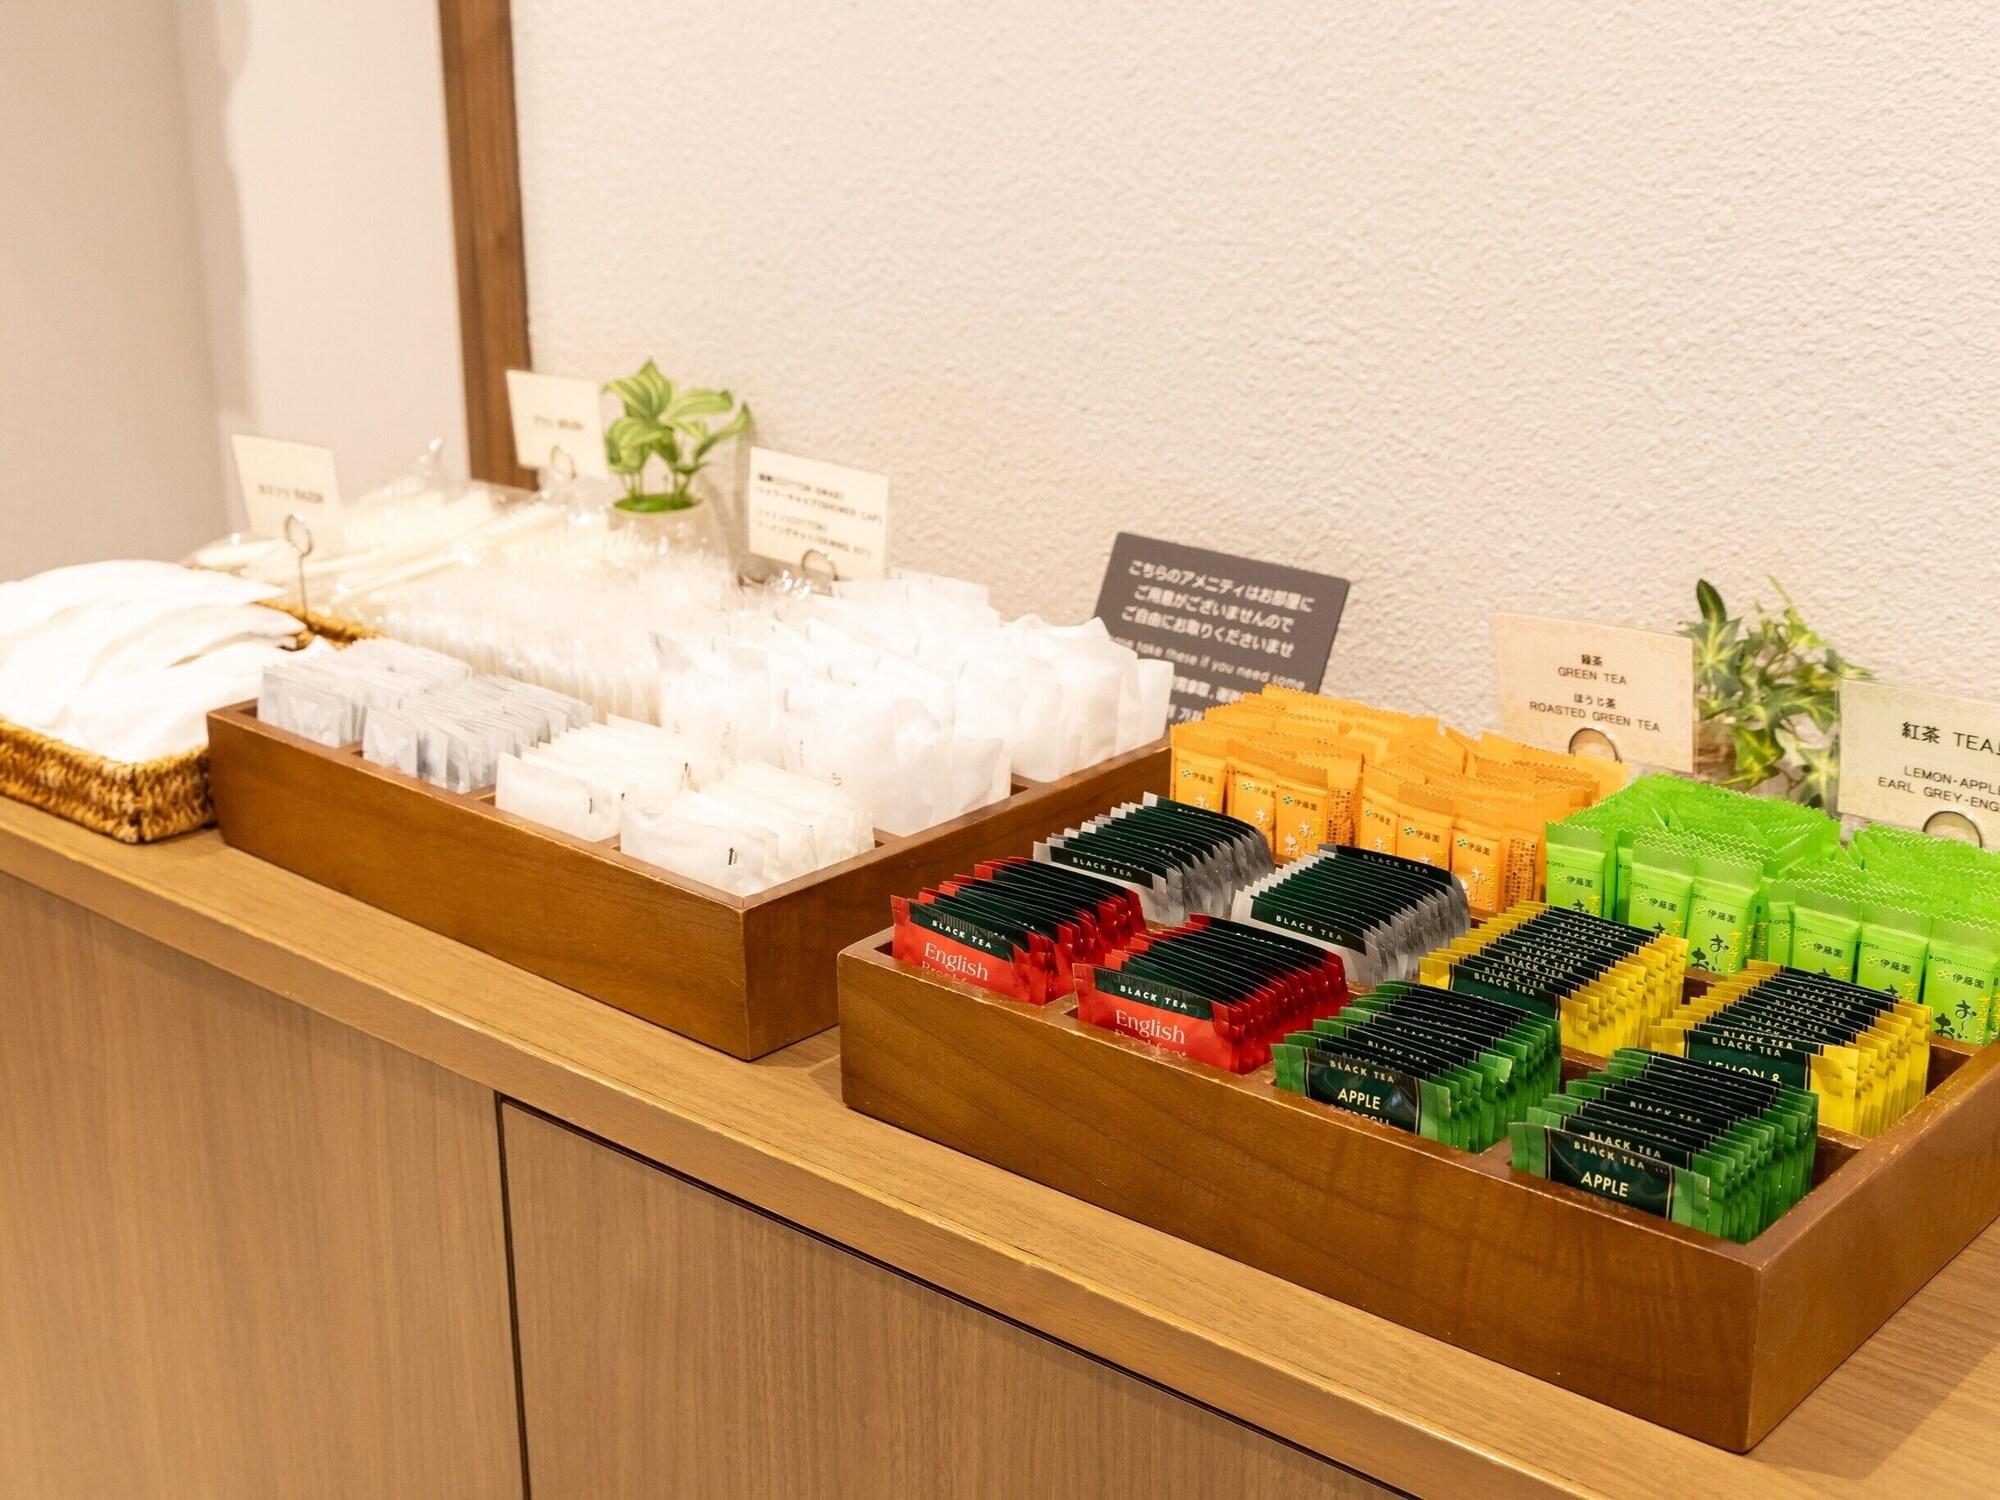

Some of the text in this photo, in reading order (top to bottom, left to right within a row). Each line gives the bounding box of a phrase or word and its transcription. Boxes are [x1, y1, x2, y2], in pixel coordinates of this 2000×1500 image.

[1211, 660, 1236, 675] you
[1236, 666, 1271, 682] need
[1558, 666, 1627, 685] GREEN TEA
[1574, 693, 1616, 709] ほうじ茶
[1529, 701, 1660, 732] ROASTED GREEN TEA
[1902, 721, 1940, 744] 紅茶
[1878, 776, 1915, 794] EARL
[1072, 856, 1106, 871] BLACK
[1112, 867, 1132, 877] TEA
[1363, 854, 1429, 874] BLACK TEA
[932, 919, 992, 949] BLACK TEA
[1276, 914, 1343, 941] BLACK TEA
[924, 942, 988, 981] English
[1504, 955, 1564, 979] BLACK TEA
[1554, 962, 1574, 973] TEA
[1474, 972, 1535, 996] BLACK TEA
[1484, 966, 1545, 990] BLACK TEA
[1953, 973, 1984, 989] 伊藤園
[1119, 985, 1187, 1010] BLACK TEA
[1115, 1009, 1185, 1044] English
[1807, 1023, 1828, 1035] TEA
[1712, 1037, 1782, 1058] BLACK TEA
[1723, 1030, 1793, 1050] BLACK TEA
[1329, 1060, 1394, 1084] BLACK TEA
[1337, 1087, 1381, 1111] APPLE
[1573, 1141, 1645, 1170] BLACK TEA
[1589, 1131, 1632, 1150] BLACK
[1638, 1145, 1661, 1159] TEA
[1581, 1171, 1629, 1198] APPLE
